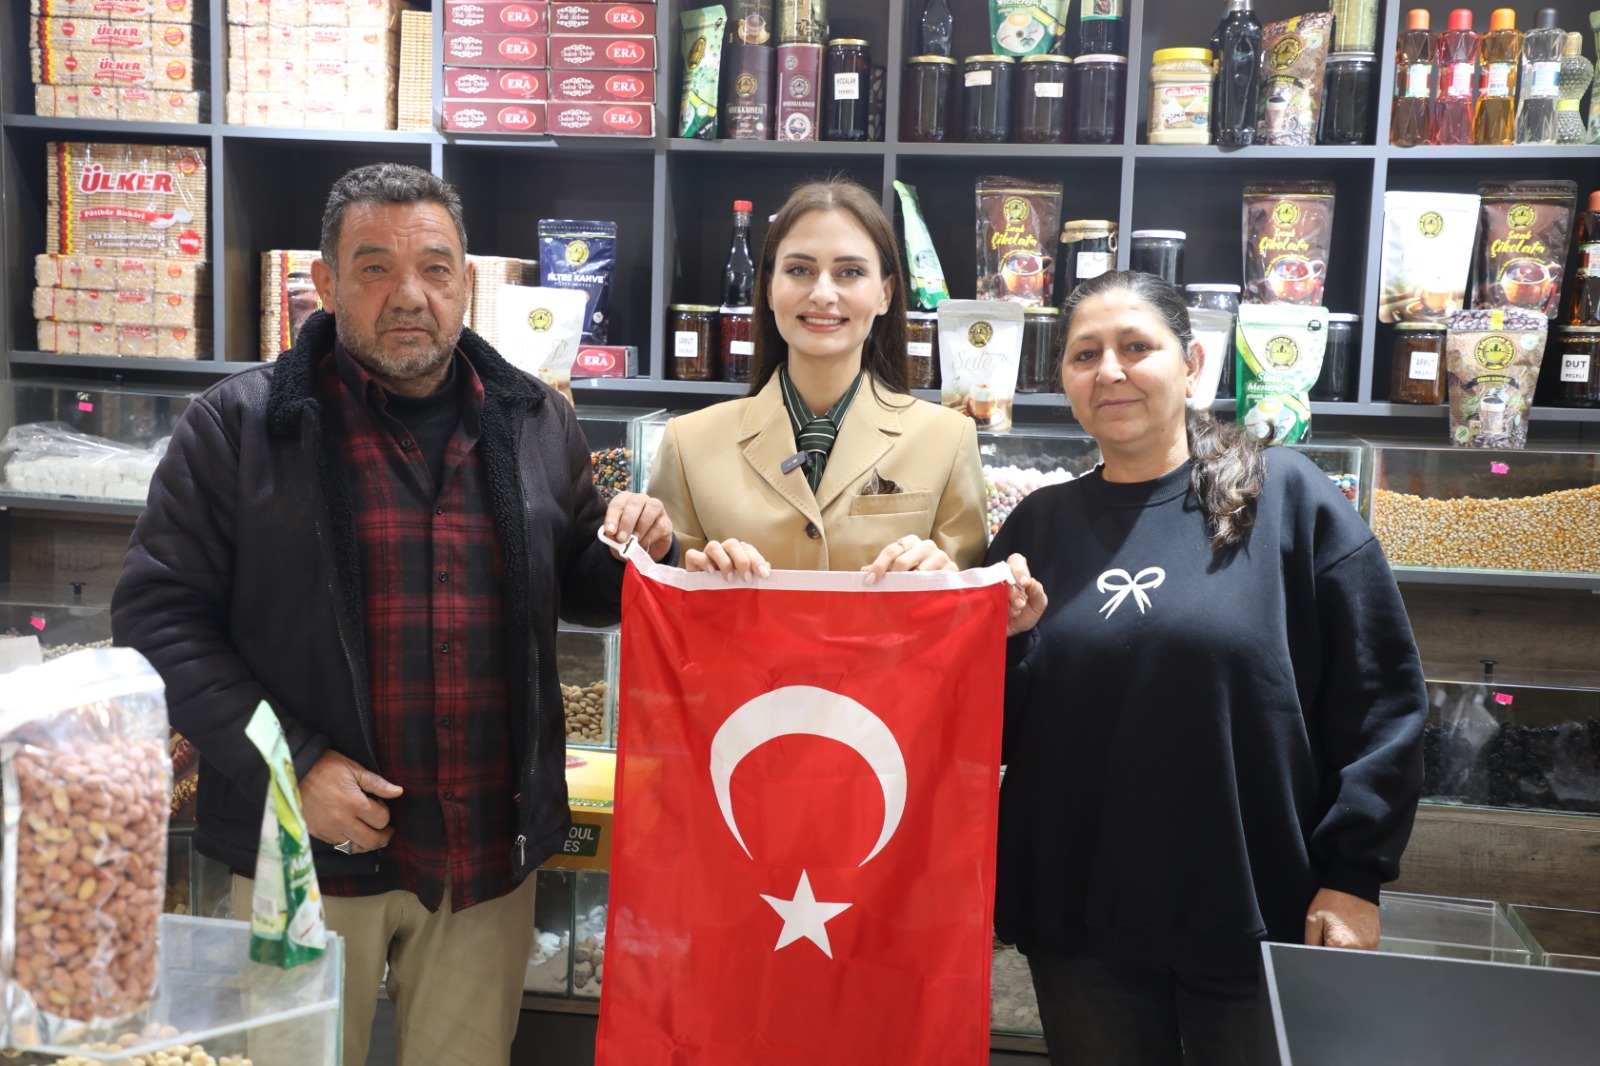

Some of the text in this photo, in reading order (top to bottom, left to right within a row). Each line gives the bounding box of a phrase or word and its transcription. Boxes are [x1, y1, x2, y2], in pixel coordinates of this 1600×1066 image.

[507, 12, 531, 23] ERA
[612, 13, 637, 23] ERA
[97, 24, 139, 37] ÜLKER
[505, 44, 530, 55] ERA
[613, 48, 637, 59] ERA
[99, 58, 141, 71] ÜLKER
[507, 79, 531, 90] ERA
[612, 81, 636, 92] ERA
[505, 113, 529, 124] ERA
[610, 114, 635, 124] ERA
[80, 165, 174, 194] ÜLKER
[991, 232, 1038, 250] Çikolata
[1258, 236, 1310, 255] Çikolata
[1490, 238, 1546, 258] Çikolata
[574, 273, 604, 284] KAHVE
[584, 356, 608, 366] ERA
[1565, 360, 1587, 369] DUT
